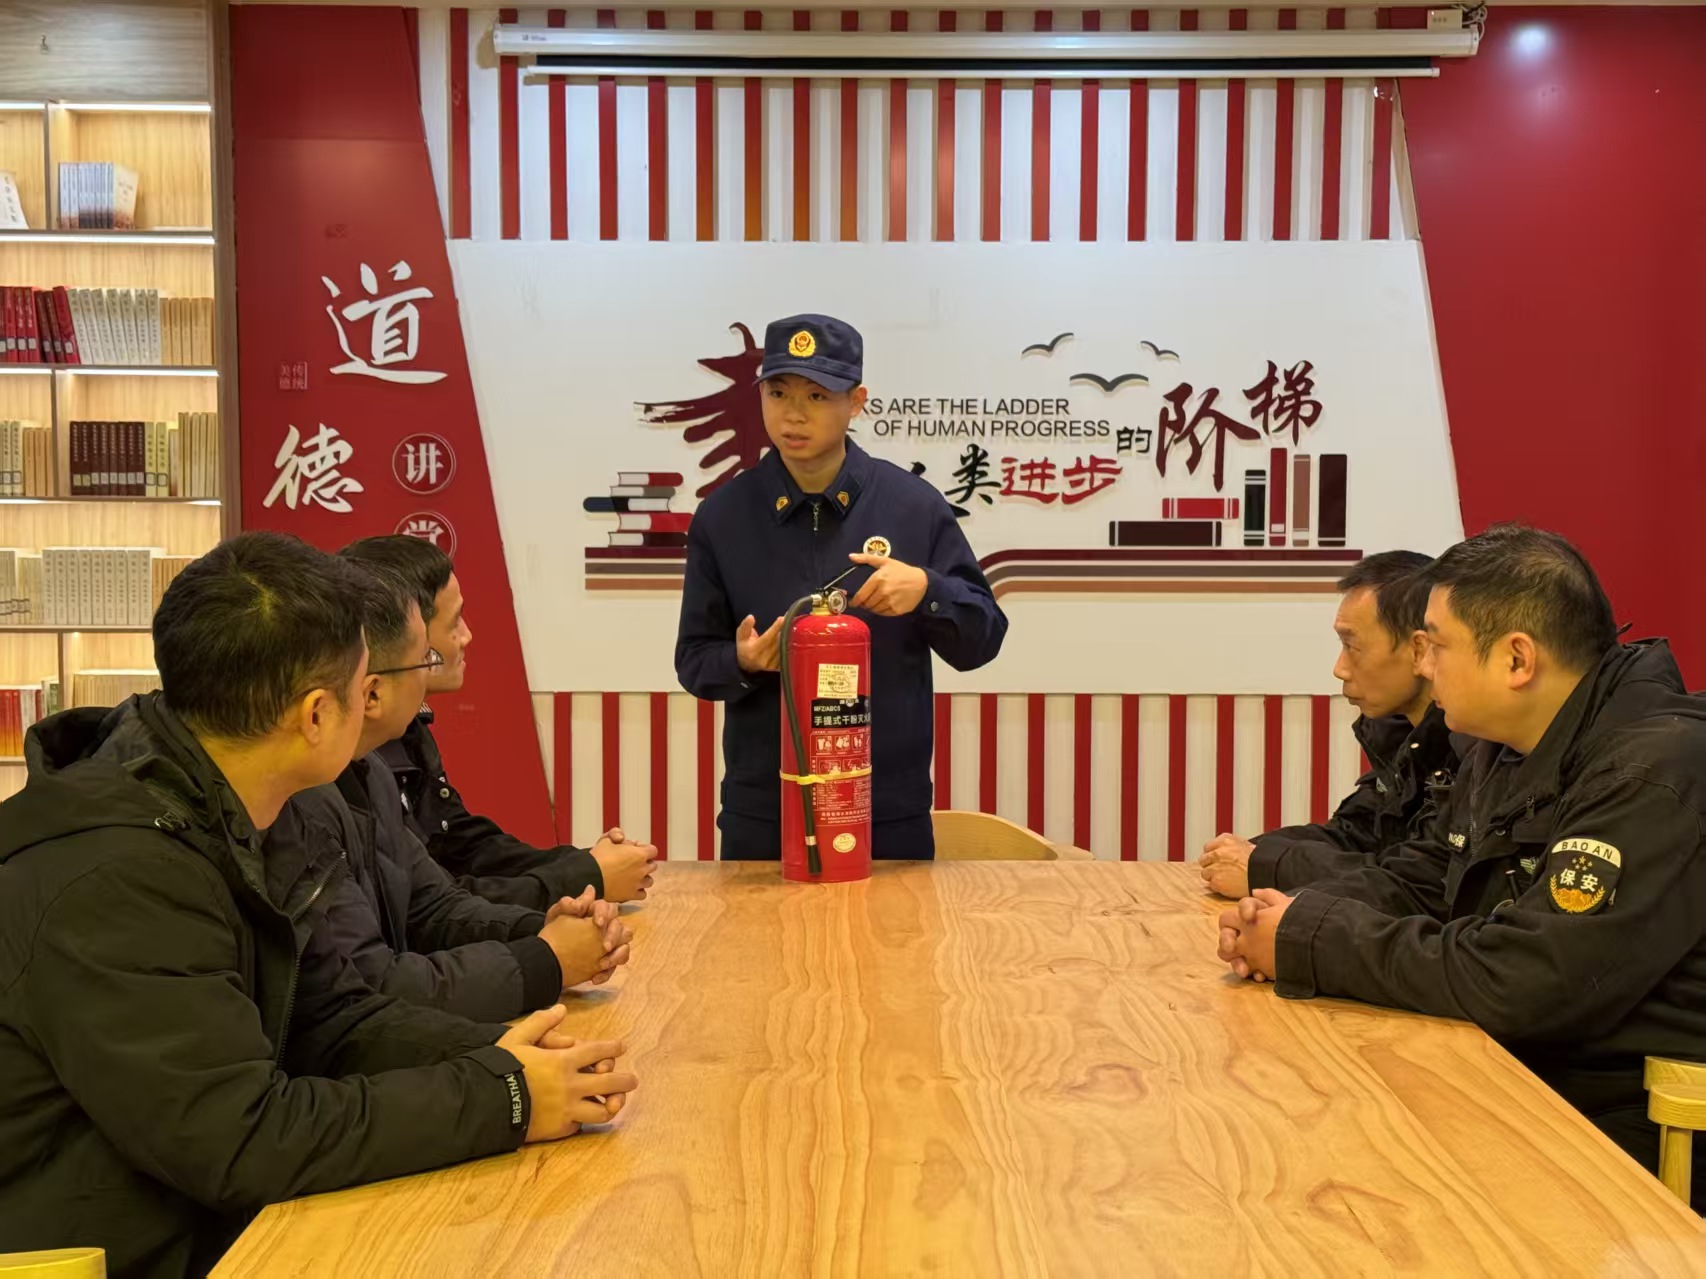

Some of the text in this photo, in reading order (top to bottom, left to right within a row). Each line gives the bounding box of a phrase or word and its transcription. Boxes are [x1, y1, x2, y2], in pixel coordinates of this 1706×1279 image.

[888, 398, 931, 415] ARE
[937, 398, 978, 415] THE
[983, 398, 1070, 415] LADDER
[873, 419, 1110, 437] OF HUMAN PROGRESS
[1559, 868, 1599, 893] 保安
